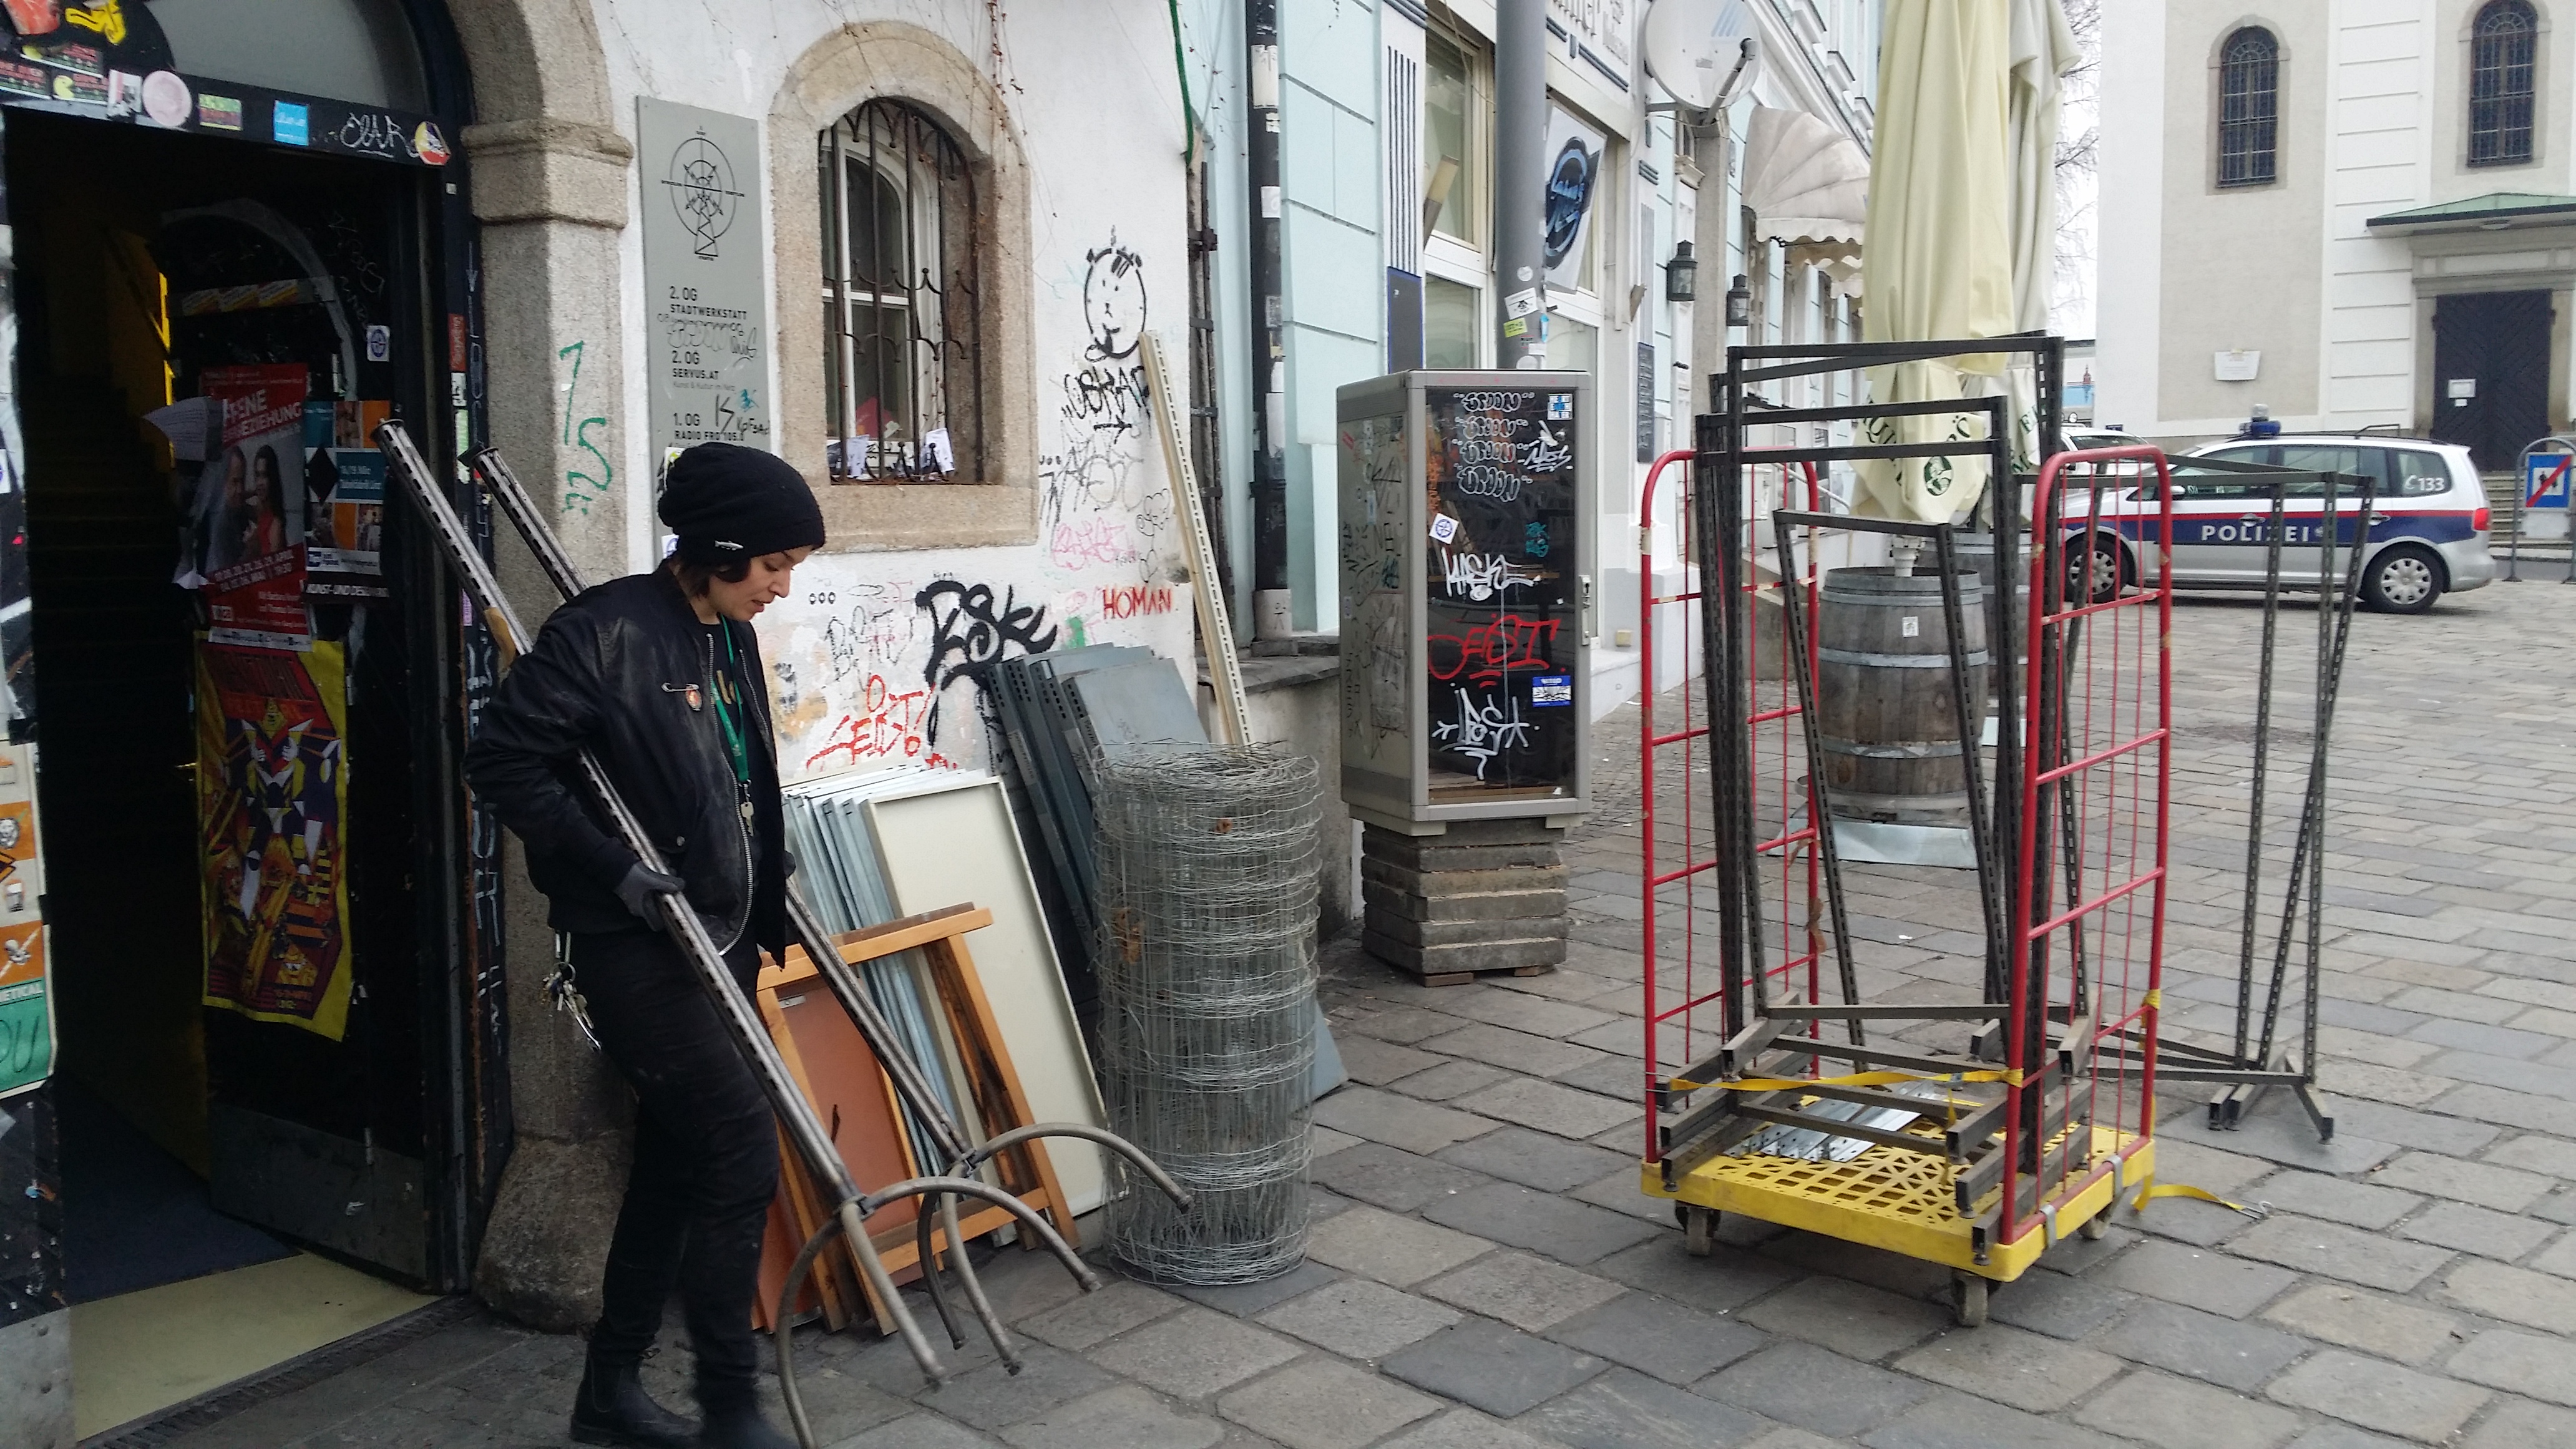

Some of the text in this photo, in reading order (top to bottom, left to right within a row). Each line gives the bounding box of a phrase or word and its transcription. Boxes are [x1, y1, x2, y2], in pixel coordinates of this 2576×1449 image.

[670, 285, 698, 301] 2. OG
[670, 303, 747, 320] STADTWERKSTATT
[671, 350, 700, 365] 2. OG
[673, 368, 719, 379] SERVUS.AT
[685, 413, 700, 427] OG
[675, 430, 701, 440] RADIO
[2417, 477, 2444, 491] 133
[1103, 585, 1171, 620] HOMAN
